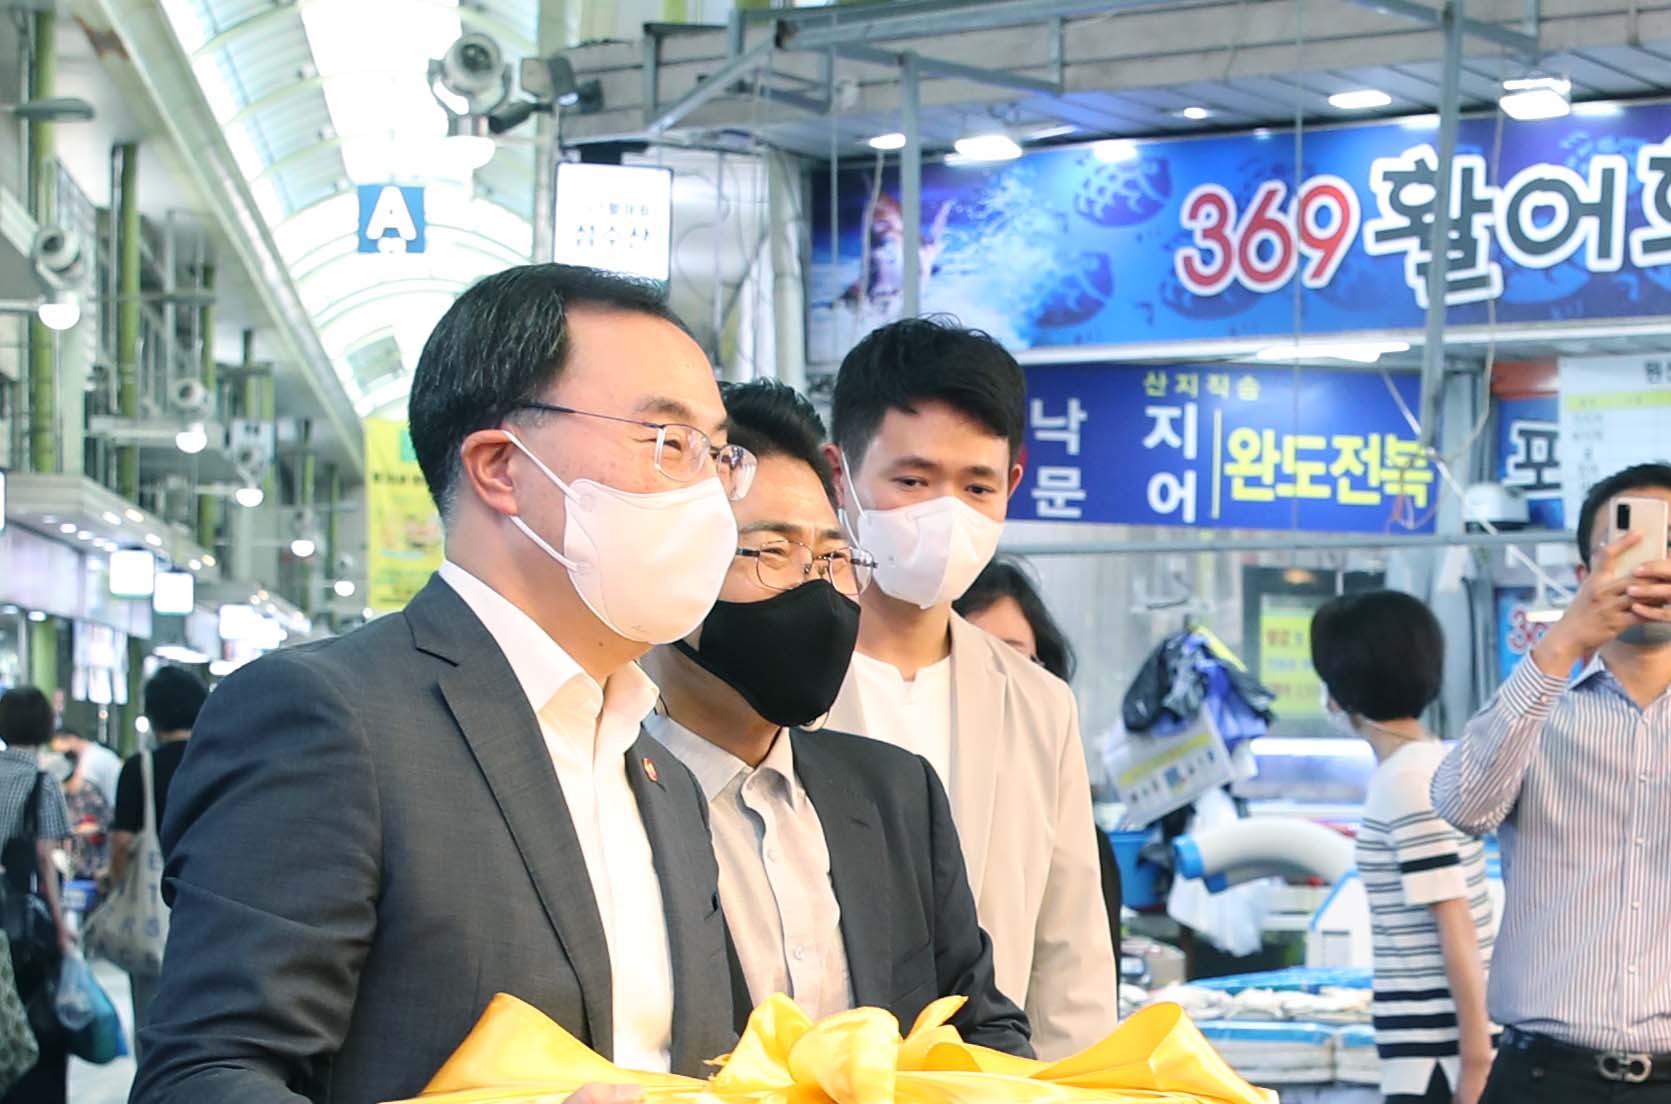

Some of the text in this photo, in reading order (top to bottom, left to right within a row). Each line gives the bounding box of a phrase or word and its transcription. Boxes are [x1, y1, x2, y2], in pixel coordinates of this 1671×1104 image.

[366, 186, 417, 241] A
[1177, 176, 1360, 295] 369
[1223, 427, 1436, 509] 완도전복
